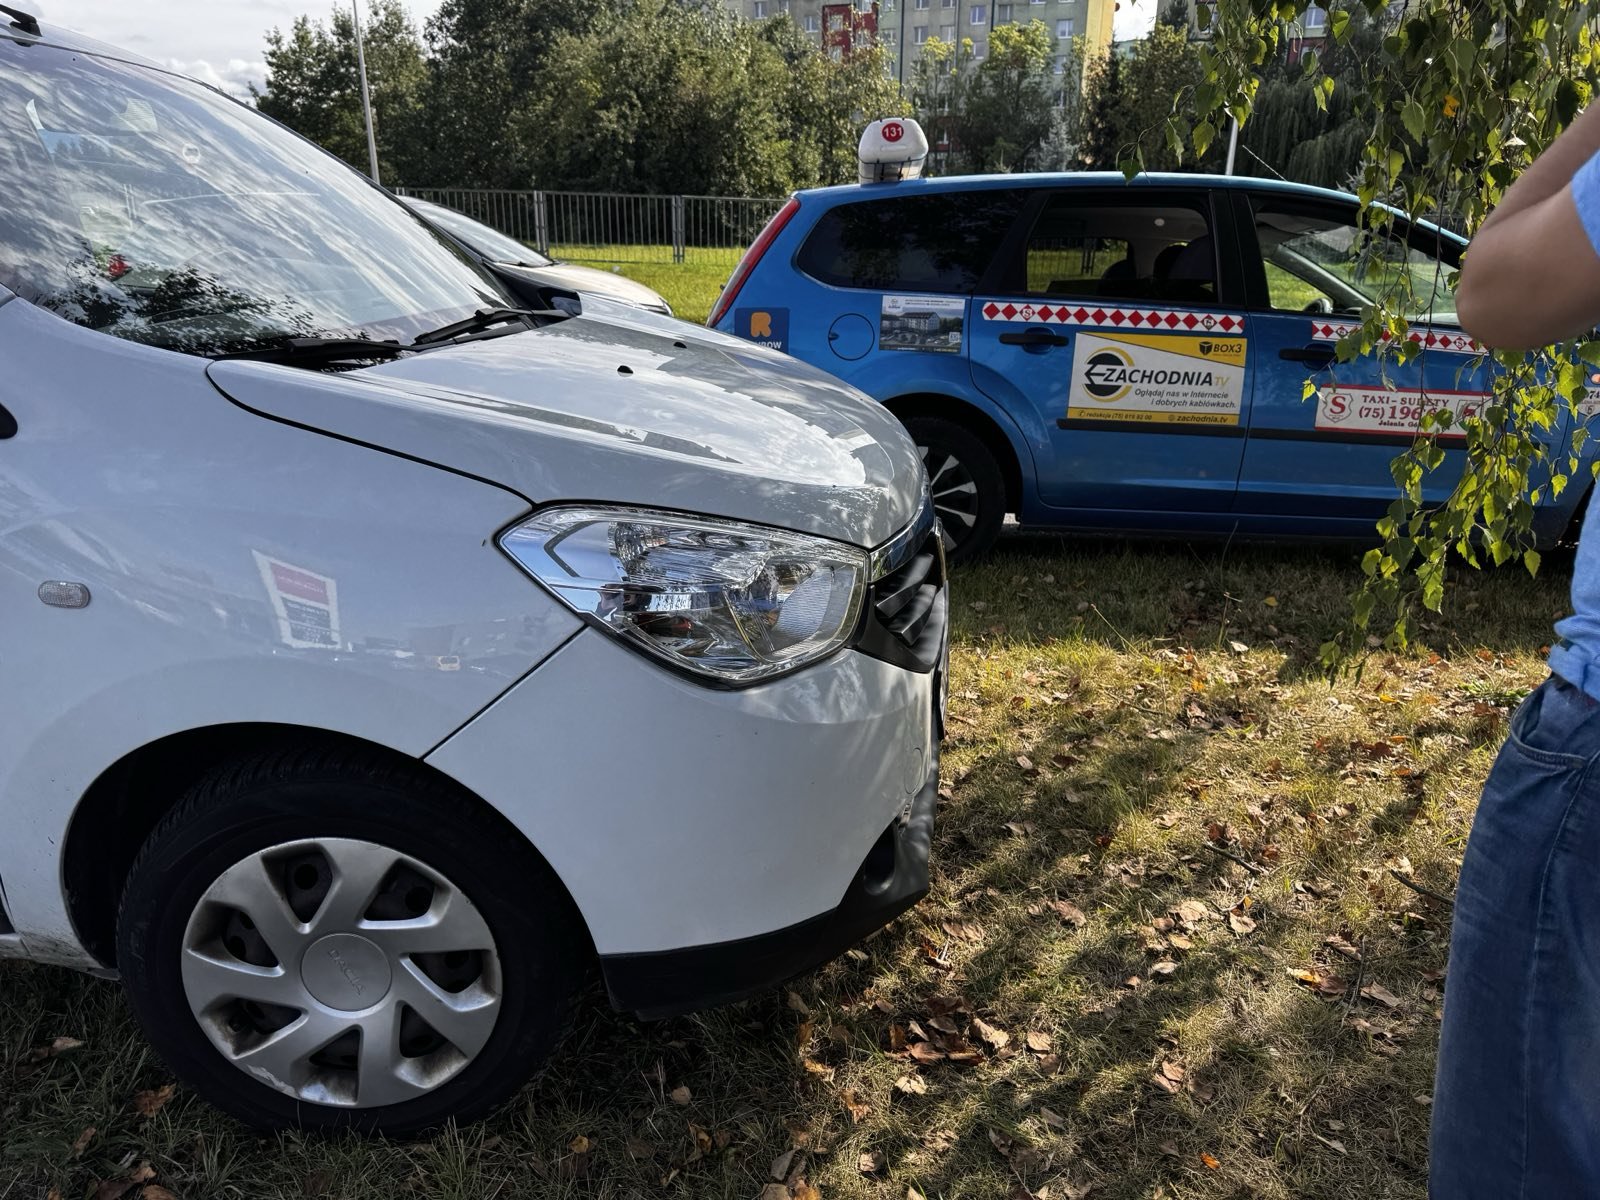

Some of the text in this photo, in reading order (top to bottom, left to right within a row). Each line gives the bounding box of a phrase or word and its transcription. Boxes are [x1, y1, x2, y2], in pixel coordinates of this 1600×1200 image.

[884, 126, 902, 138] 131
[750, 311, 771, 338] R
[1213, 343, 1242, 353] BOX3
[1103, 368, 1213, 386] ZACHODNIA
[1135, 388, 1165, 398] Oglądaj
[1190, 391, 1229, 399] Internecie
[1362, 395, 1390, 404] TAXI
[1155, 399, 1188, 407] dobrych
[1330, 396, 1346, 414] S
[1359, 405, 1385, 419] (75)
[1177, 414, 1229, 423] zachodnia.tv
[328, 949, 367, 996] DACIA
